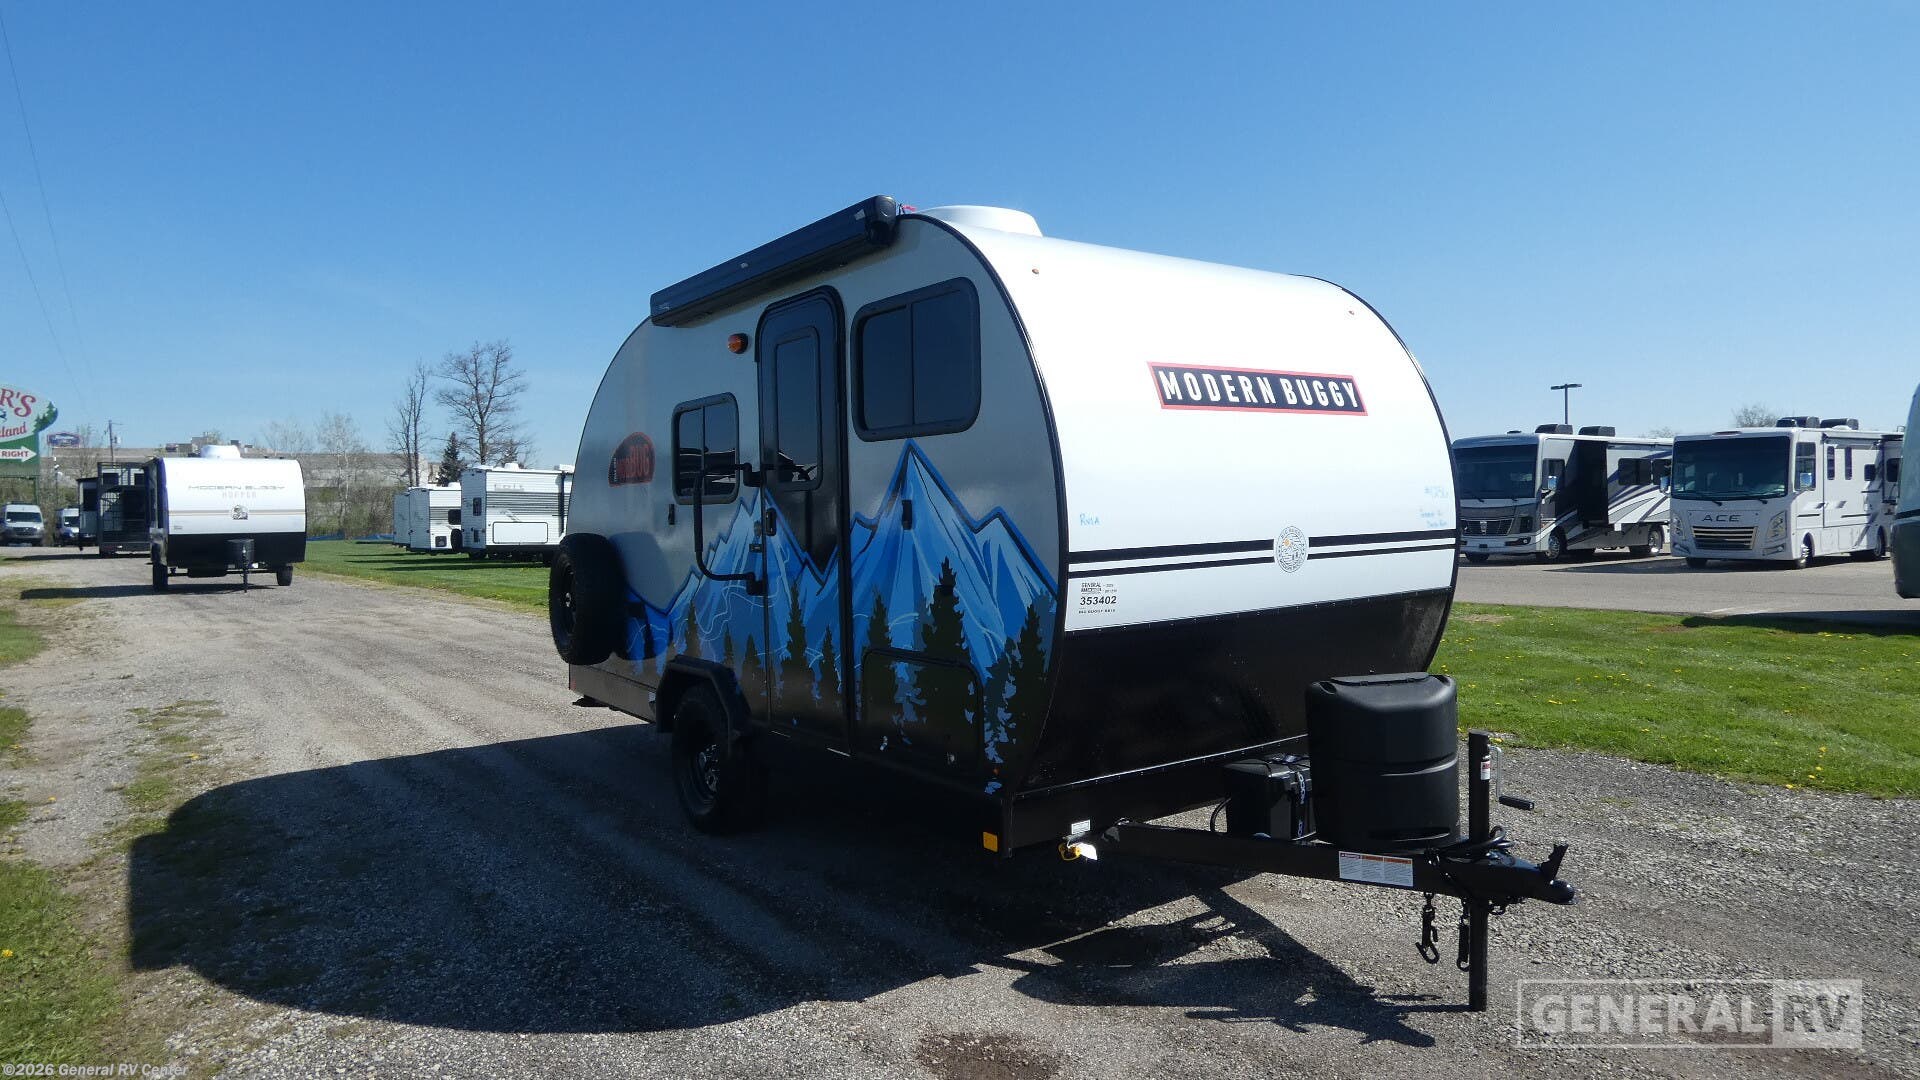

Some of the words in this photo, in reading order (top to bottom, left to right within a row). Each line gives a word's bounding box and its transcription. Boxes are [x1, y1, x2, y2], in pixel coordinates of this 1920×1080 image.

[1158, 370, 1277, 405] MODERN
[1279, 377, 1359, 408] BUGGY
[2, 450, 29, 458] RIGHT
[1701, 514, 1742, 522] ACE
[1080, 595, 1117, 606] 353402
